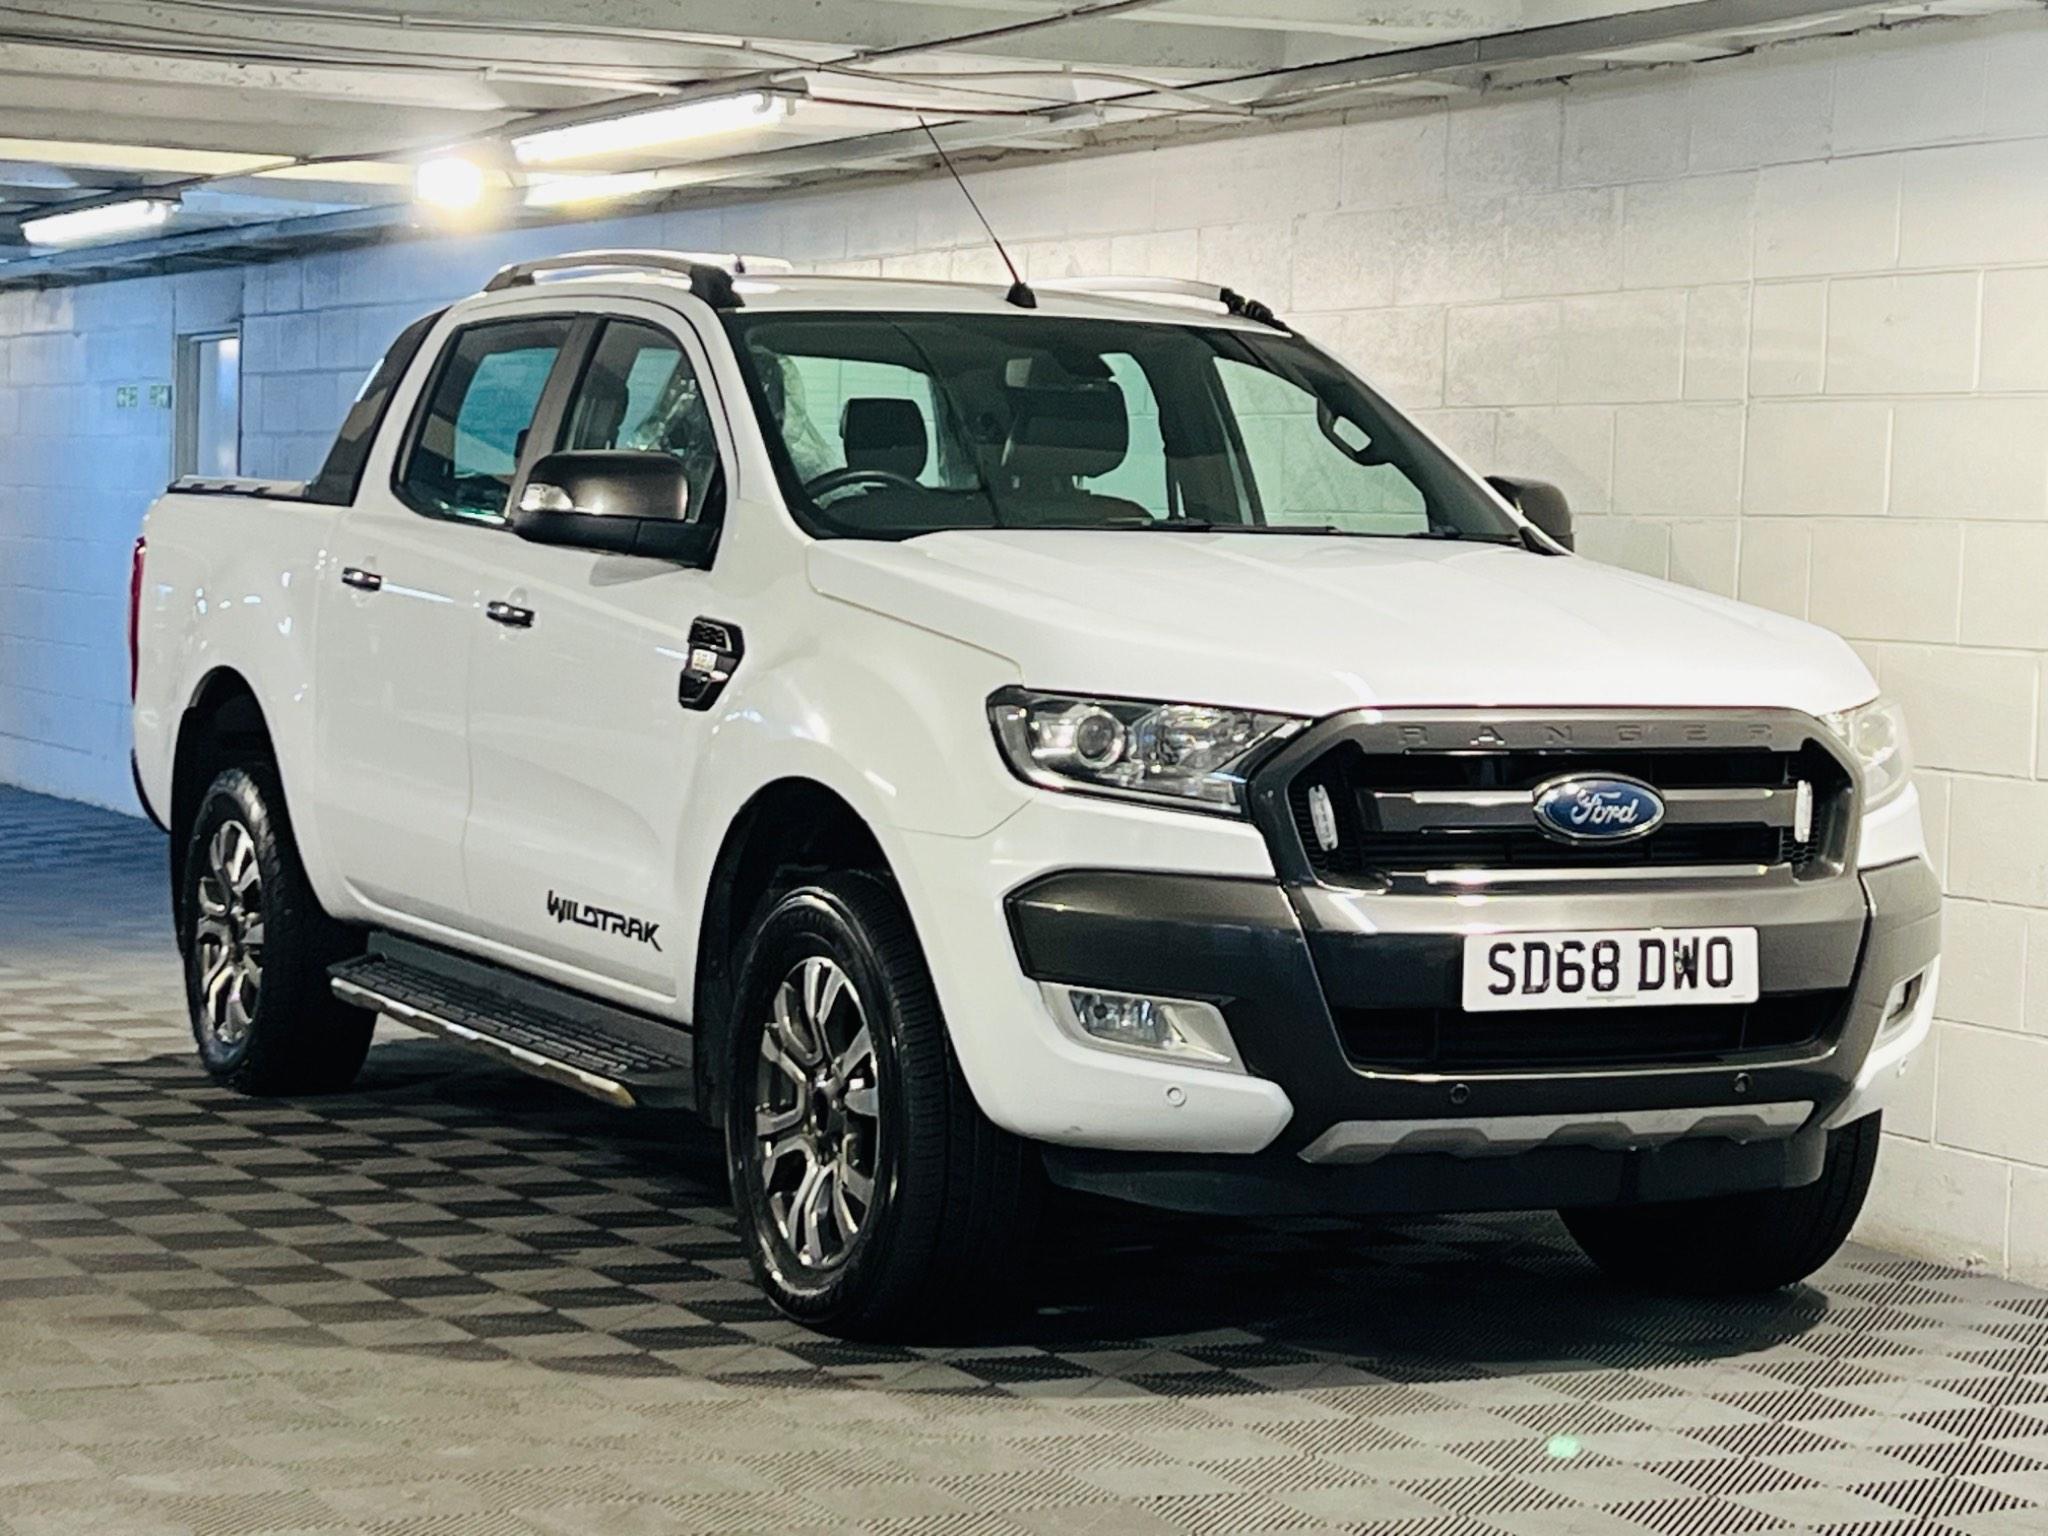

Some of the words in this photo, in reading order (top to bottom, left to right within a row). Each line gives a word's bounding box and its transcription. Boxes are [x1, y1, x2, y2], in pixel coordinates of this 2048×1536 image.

[1399, 725, 1775, 746] RANGER
[1570, 789, 1638, 825] Ford
[547, 889, 663, 953] WILDTRAK
[1488, 940, 1621, 995] SD68
[1638, 936, 1733, 990] DWO
